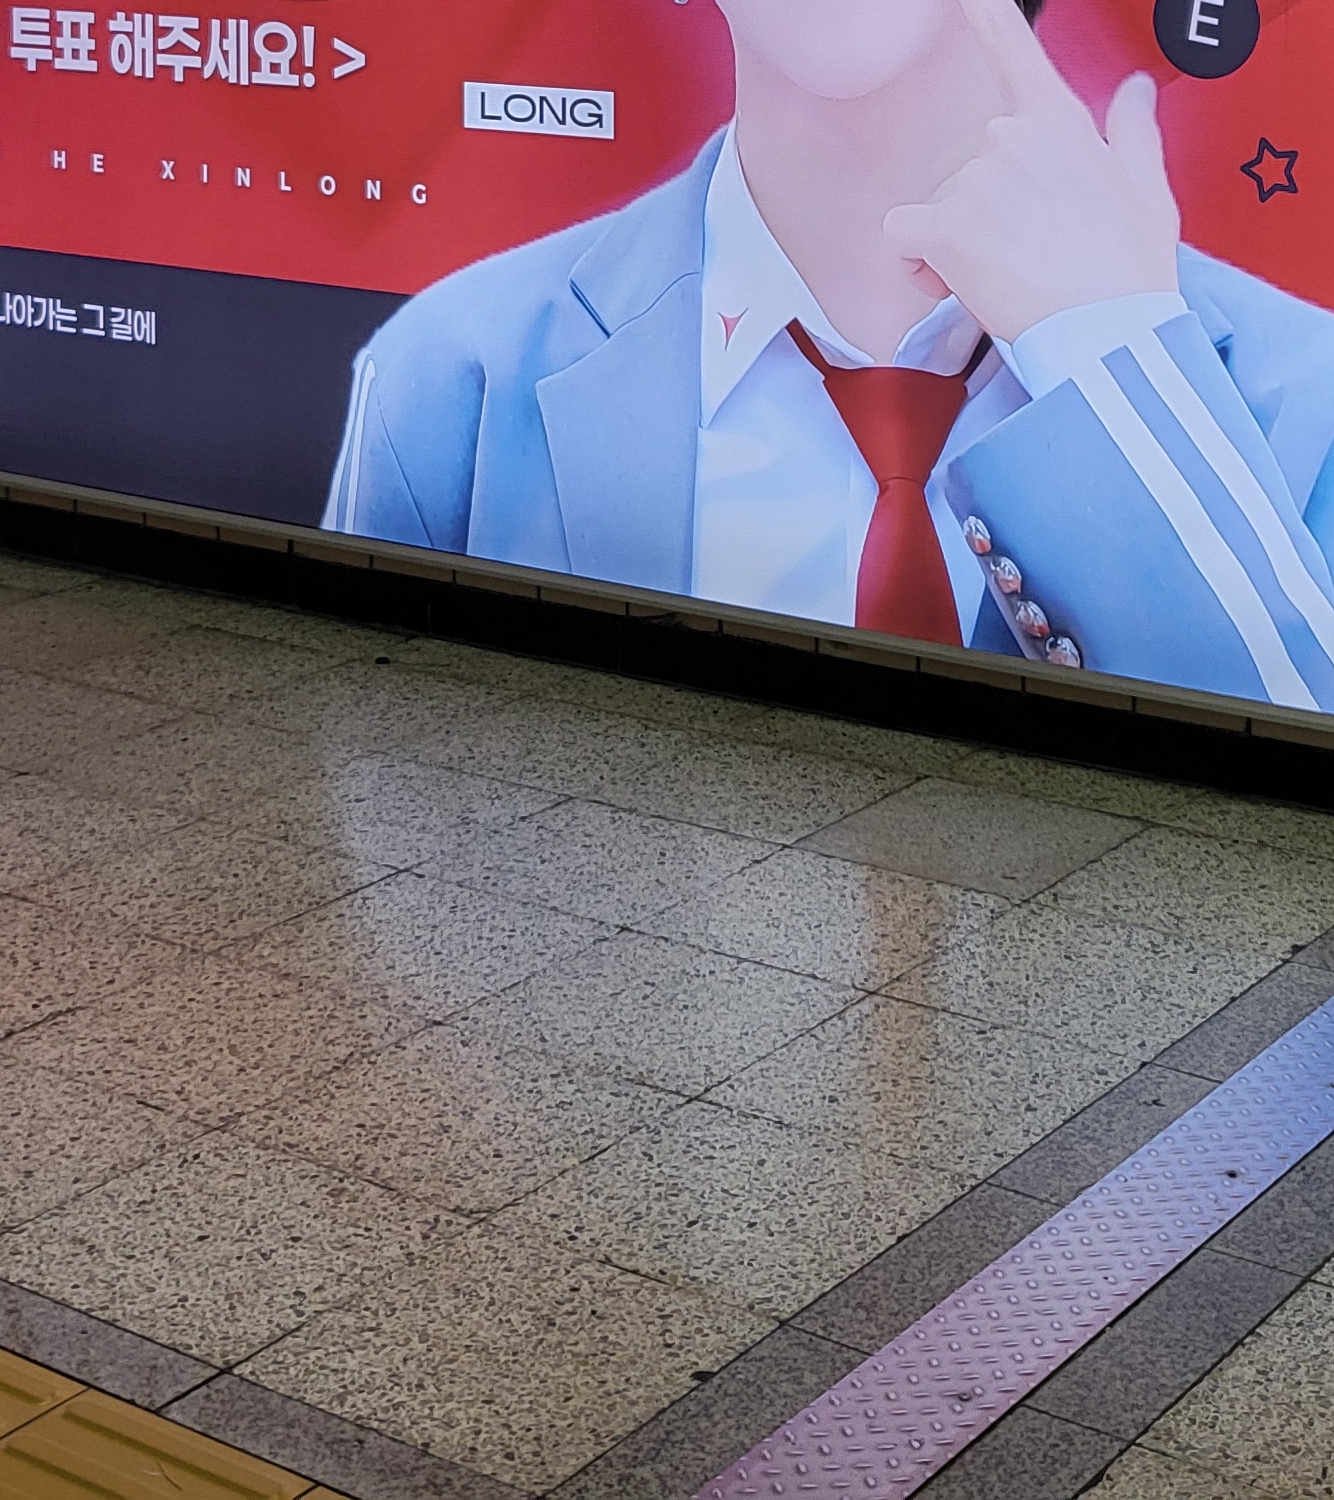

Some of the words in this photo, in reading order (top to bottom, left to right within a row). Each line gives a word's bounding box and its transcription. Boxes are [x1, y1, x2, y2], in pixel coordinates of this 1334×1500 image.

[8, 7, 99, 74] 투표
[109, 10, 317, 88] 해주세요!
[478, 91, 606, 130] LONG
[52, 149, 107, 175] HE
[160, 158, 430, 205] XINLONG
[81, 303, 106, 337] 그
[109, 307, 157, 346] 길에
